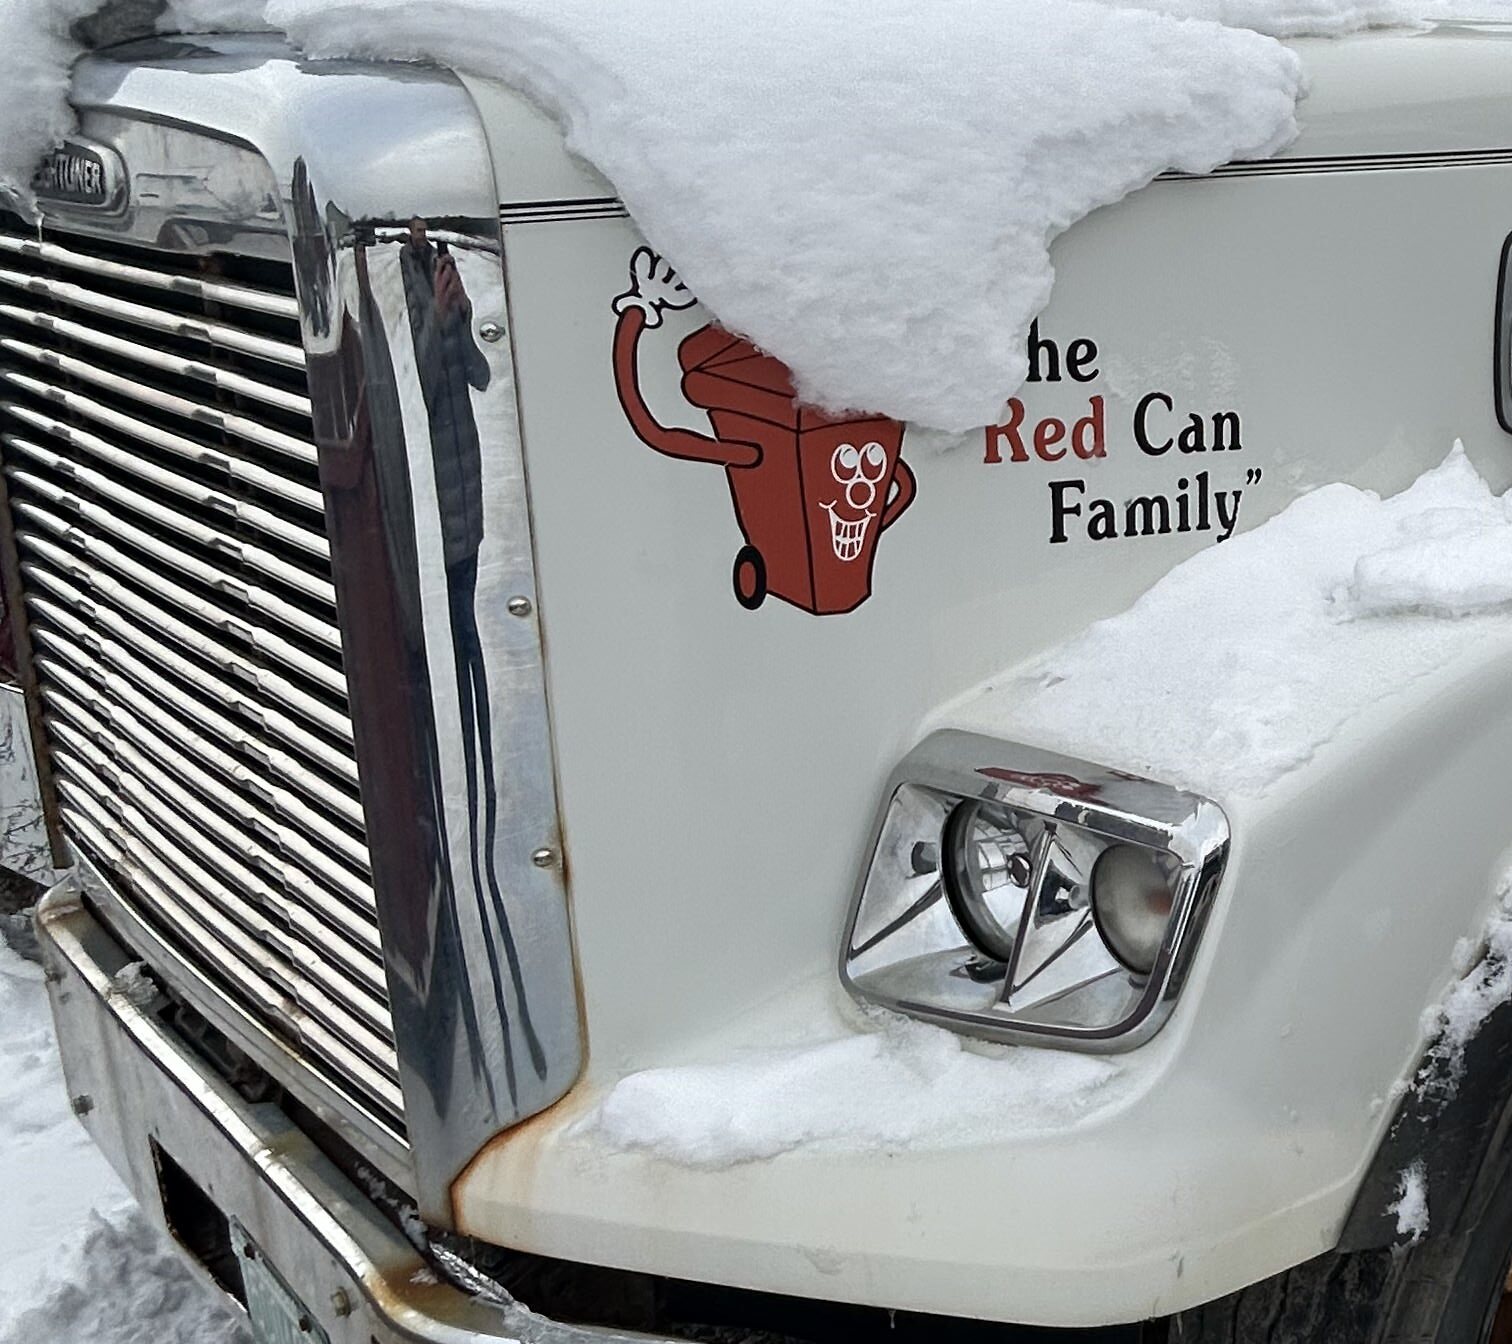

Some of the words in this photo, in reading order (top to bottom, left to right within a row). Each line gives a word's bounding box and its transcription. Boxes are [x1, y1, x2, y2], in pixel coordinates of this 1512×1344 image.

[1026, 316, 1099, 382] he
[983, 395, 1107, 464] Red
[1133, 392, 1242, 456] Can
